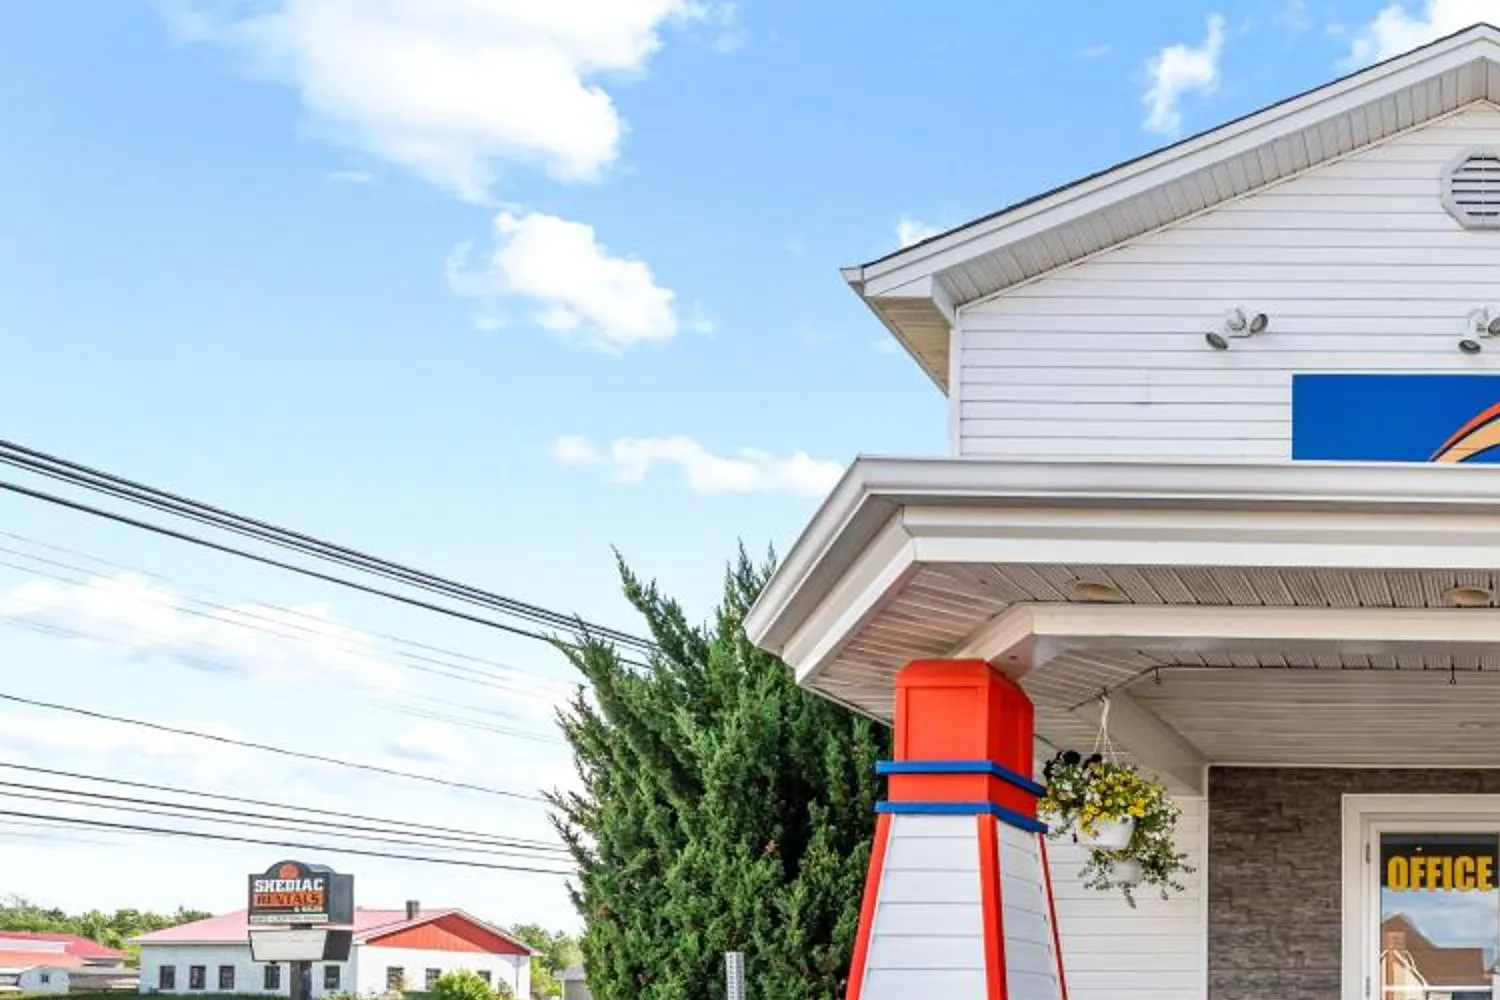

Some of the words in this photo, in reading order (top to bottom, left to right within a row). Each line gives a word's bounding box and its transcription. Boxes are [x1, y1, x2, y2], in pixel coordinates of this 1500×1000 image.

[1387, 856, 1493, 892] OFFICE
[255, 878, 324, 892] SHEDIAC
[256, 893, 321, 905] RENTALS
